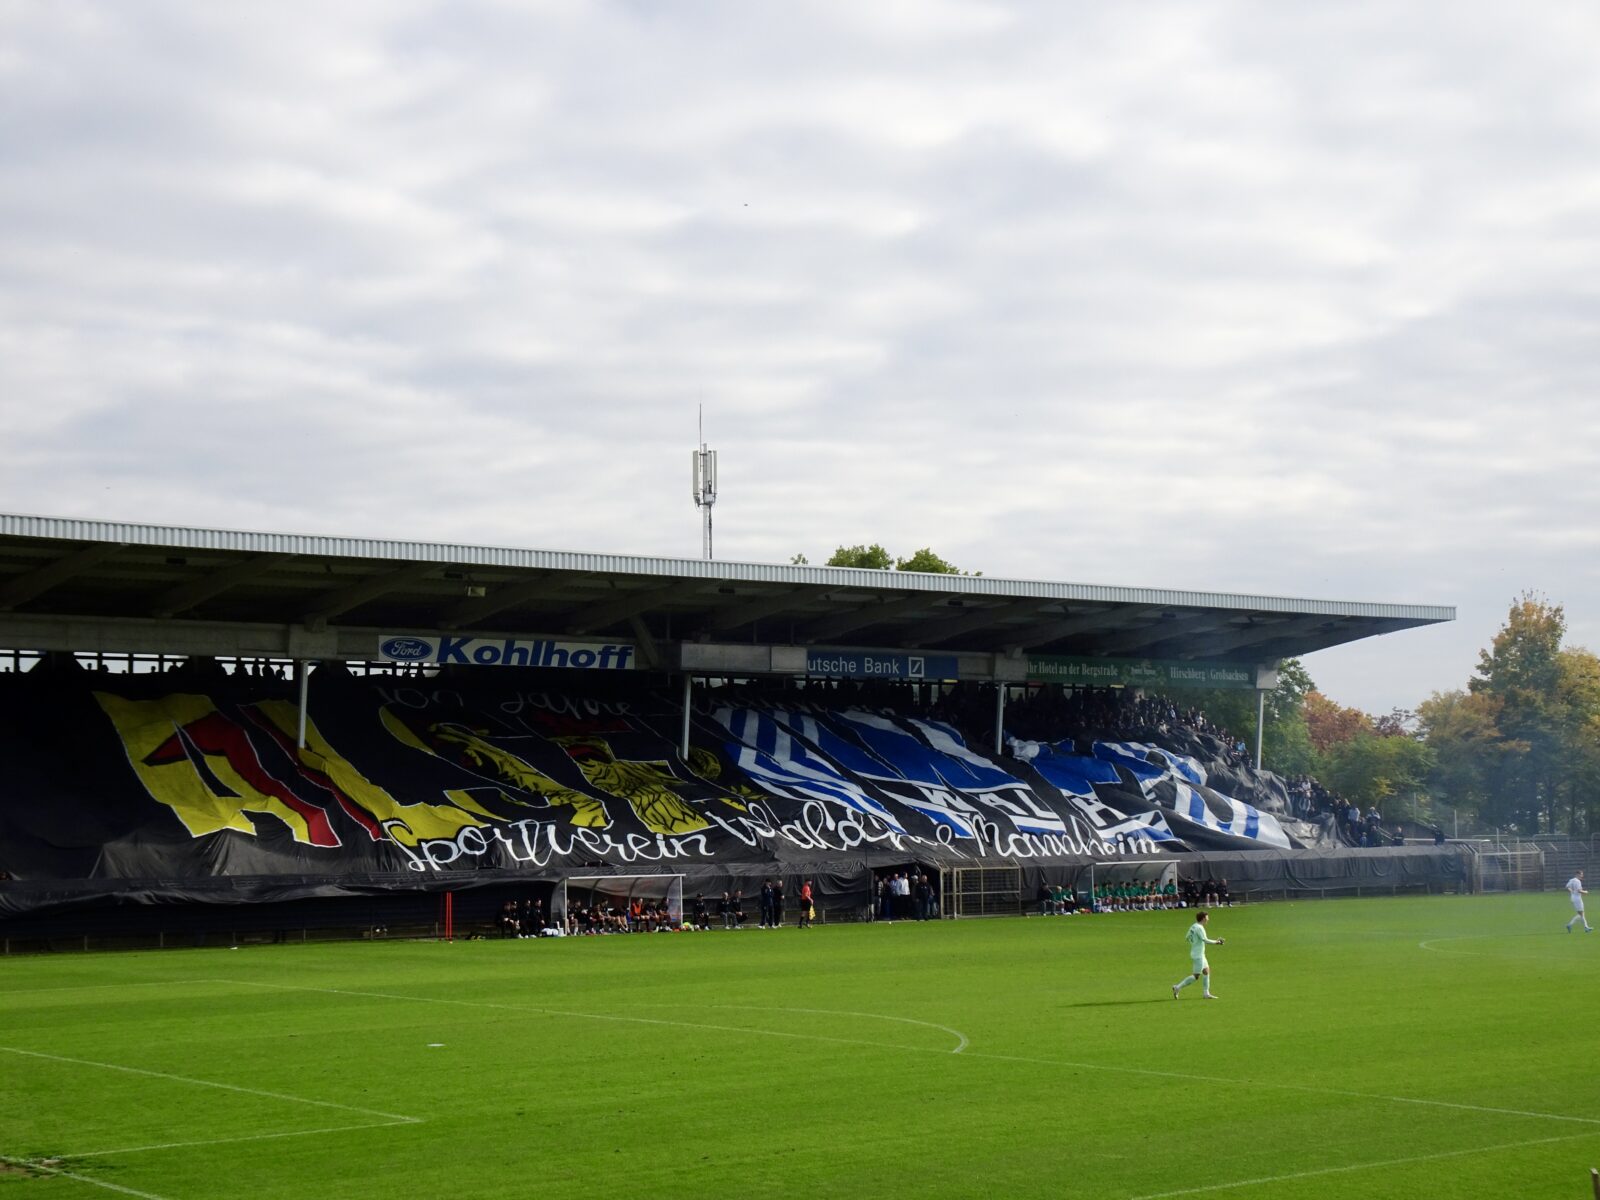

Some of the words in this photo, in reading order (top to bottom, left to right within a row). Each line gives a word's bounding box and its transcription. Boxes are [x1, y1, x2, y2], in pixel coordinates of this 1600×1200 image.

[391, 641, 422, 656] Ford
[437, 637, 634, 669] Kohlhoff
[808, 657, 857, 673] utsche
[864, 657, 899, 674] Bank
[1039, 661, 1057, 674] Hotel
[1069, 663, 1080, 675] der
[1170, 667, 1205, 682] Hirschberg
[970, 814, 1160, 859] Mannheim
